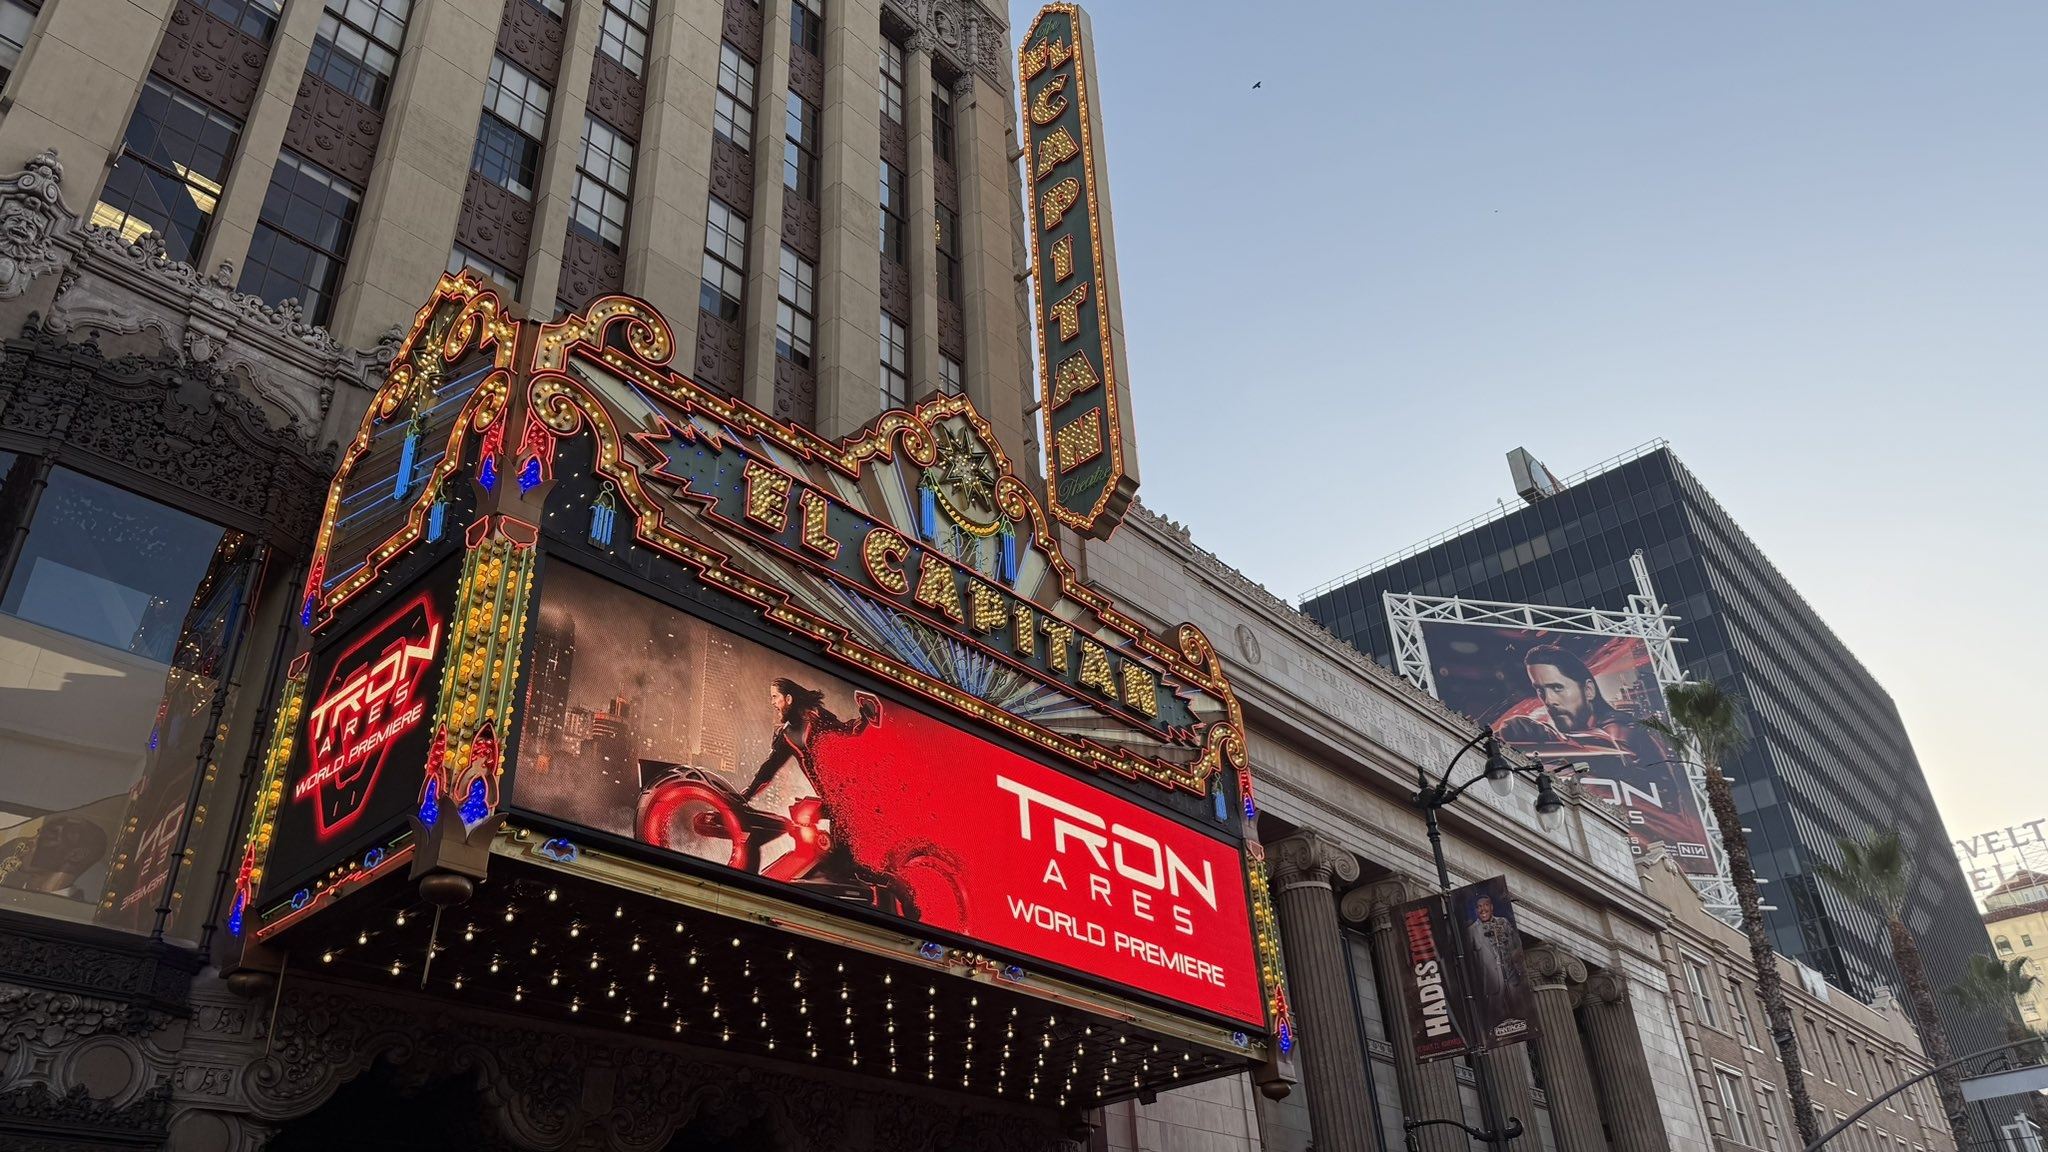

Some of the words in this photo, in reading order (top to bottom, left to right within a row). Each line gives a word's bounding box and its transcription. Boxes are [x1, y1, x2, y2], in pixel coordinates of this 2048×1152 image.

[1024, 36, 1072, 80] EL
[1031, 73, 1103, 474] CAPITAN
[744, 459, 841, 560] EL
[860, 527, 1159, 719] CAPITAN
[310, 622, 440, 740] TRON
[317, 681, 411, 759] ARES
[294, 756, 345, 799] WORLD
[347, 702, 423, 764] PREMIERE
[996, 773, 1218, 912] TRON
[1006, 894, 1106, 948] WORLD
[1114, 930, 1226, 988] PREMIERE
[1042, 858, 1194, 937] ARES
